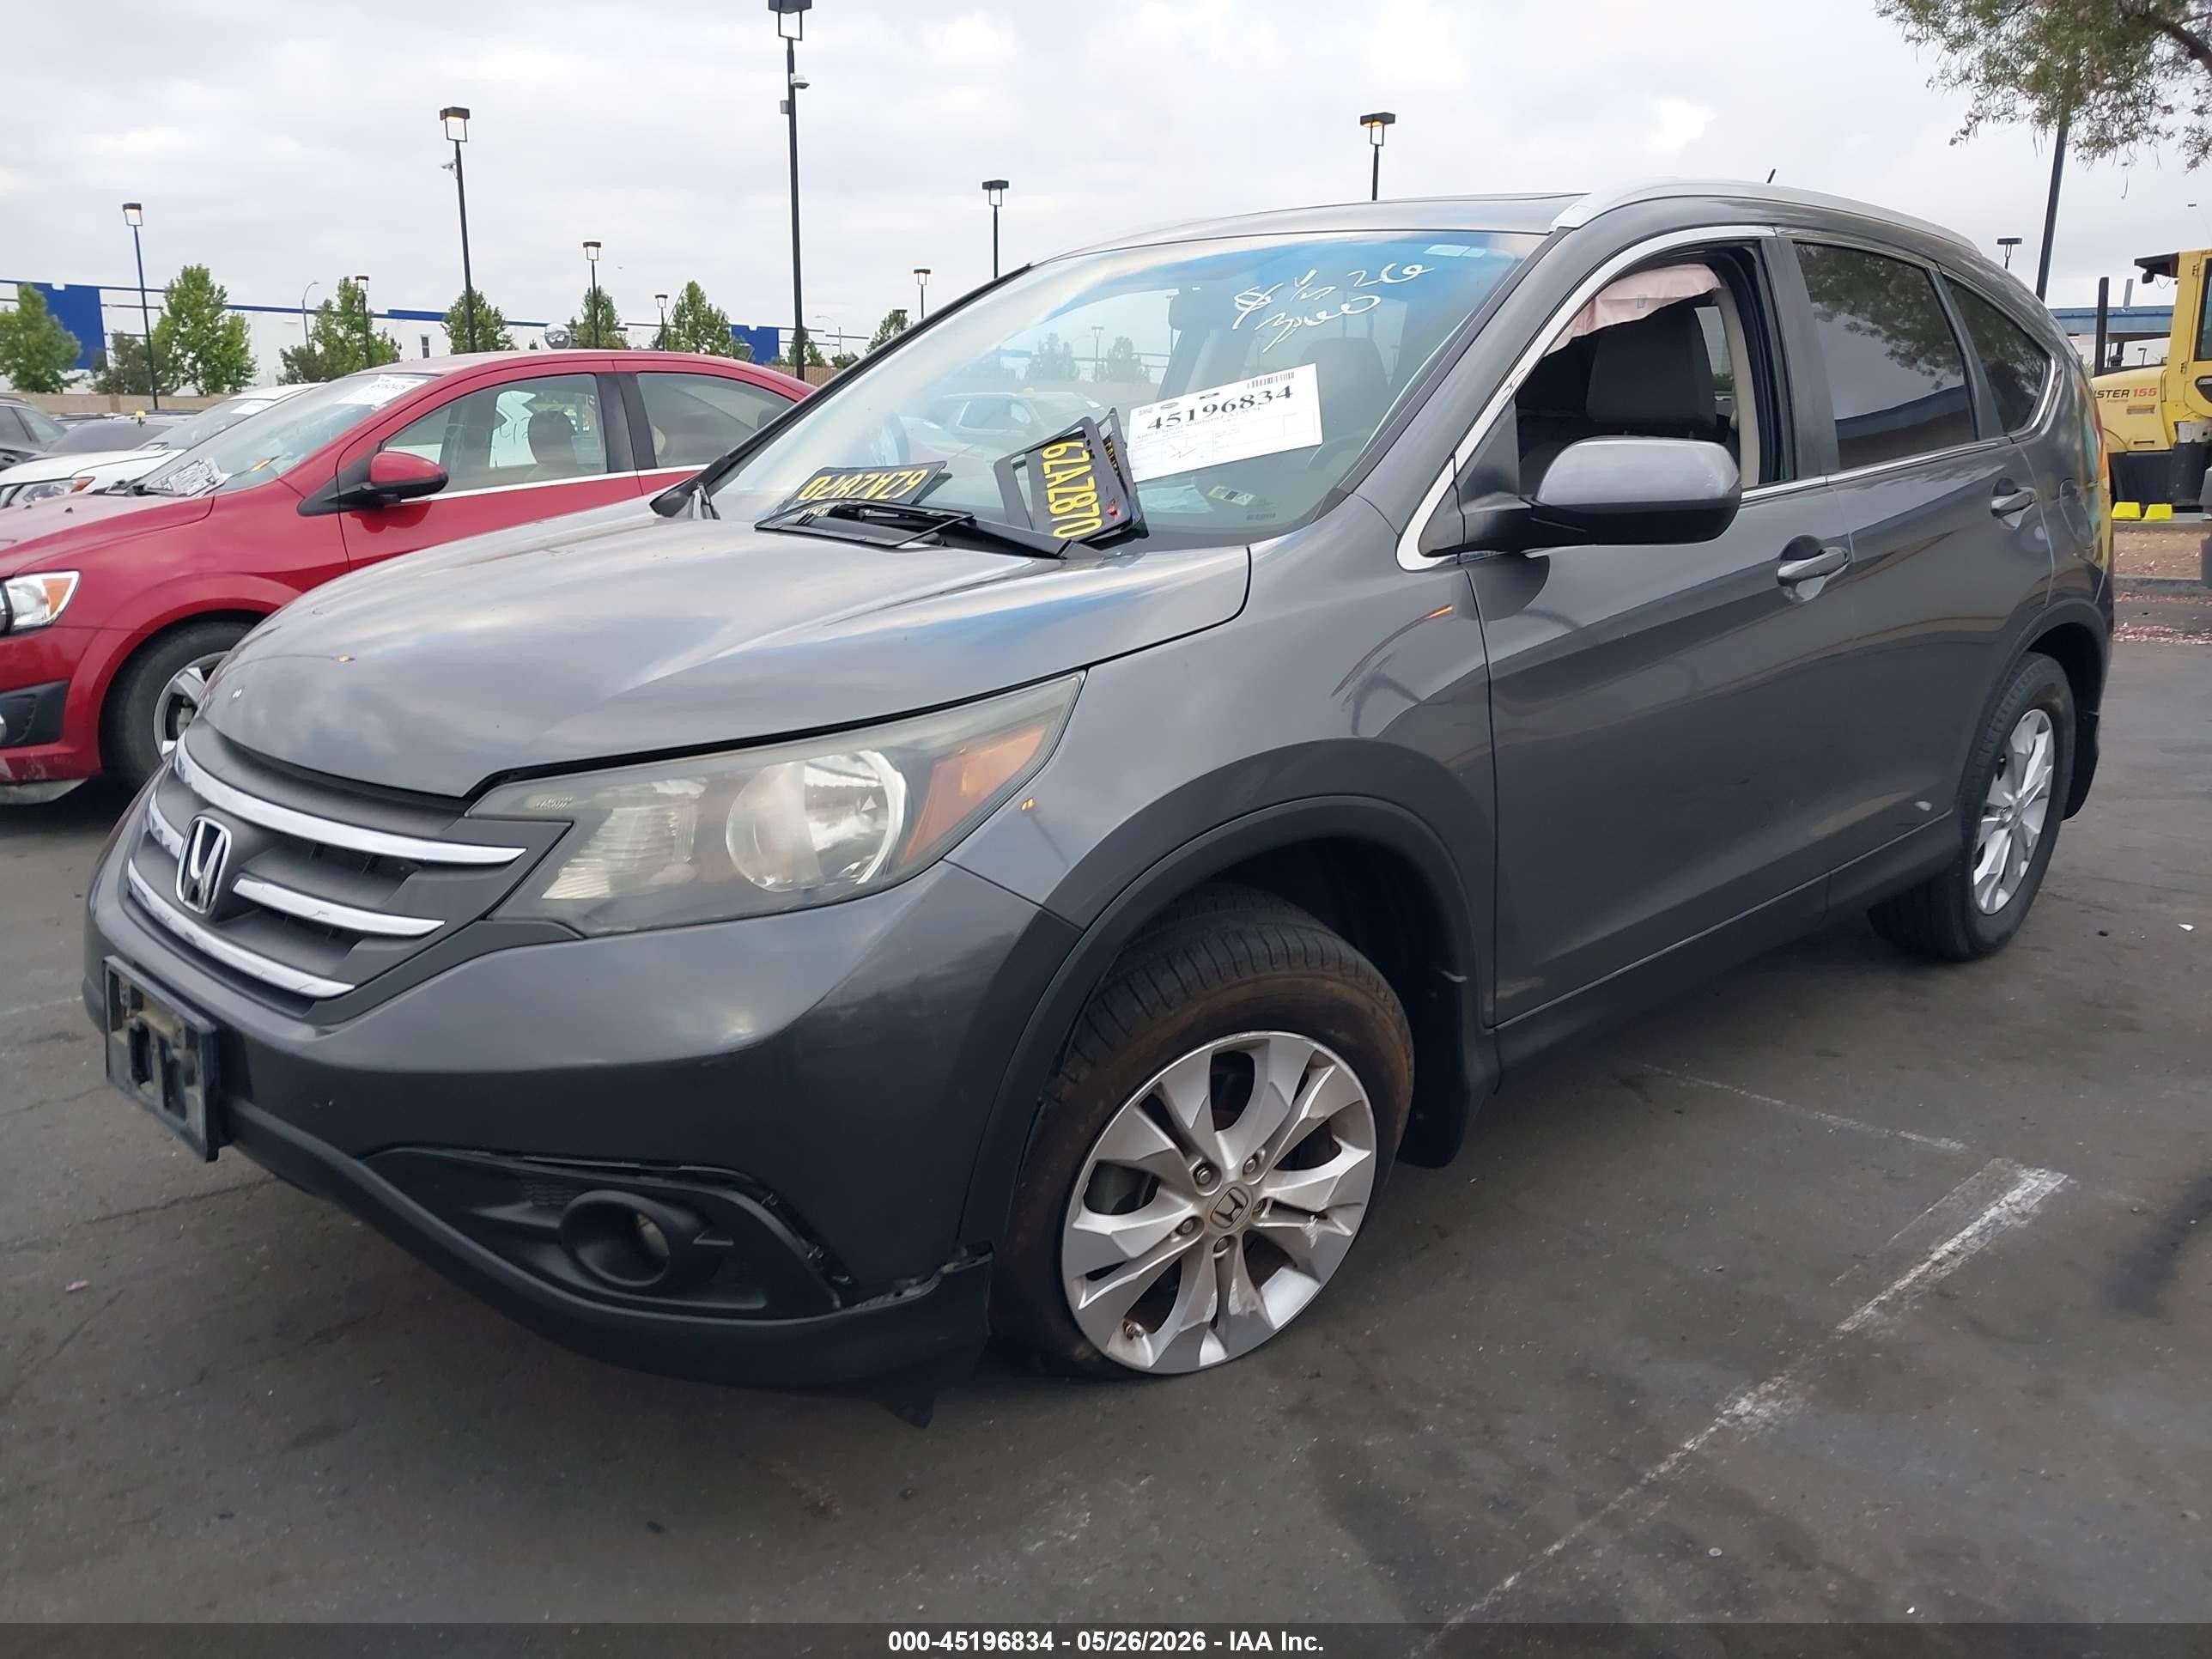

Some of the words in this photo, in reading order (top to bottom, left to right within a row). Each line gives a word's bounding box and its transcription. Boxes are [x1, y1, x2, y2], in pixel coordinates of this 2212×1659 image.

[2094, 389, 2130, 398] STER
[2133, 387, 2157, 398] 155
[1147, 385, 1293, 430] 45196834
